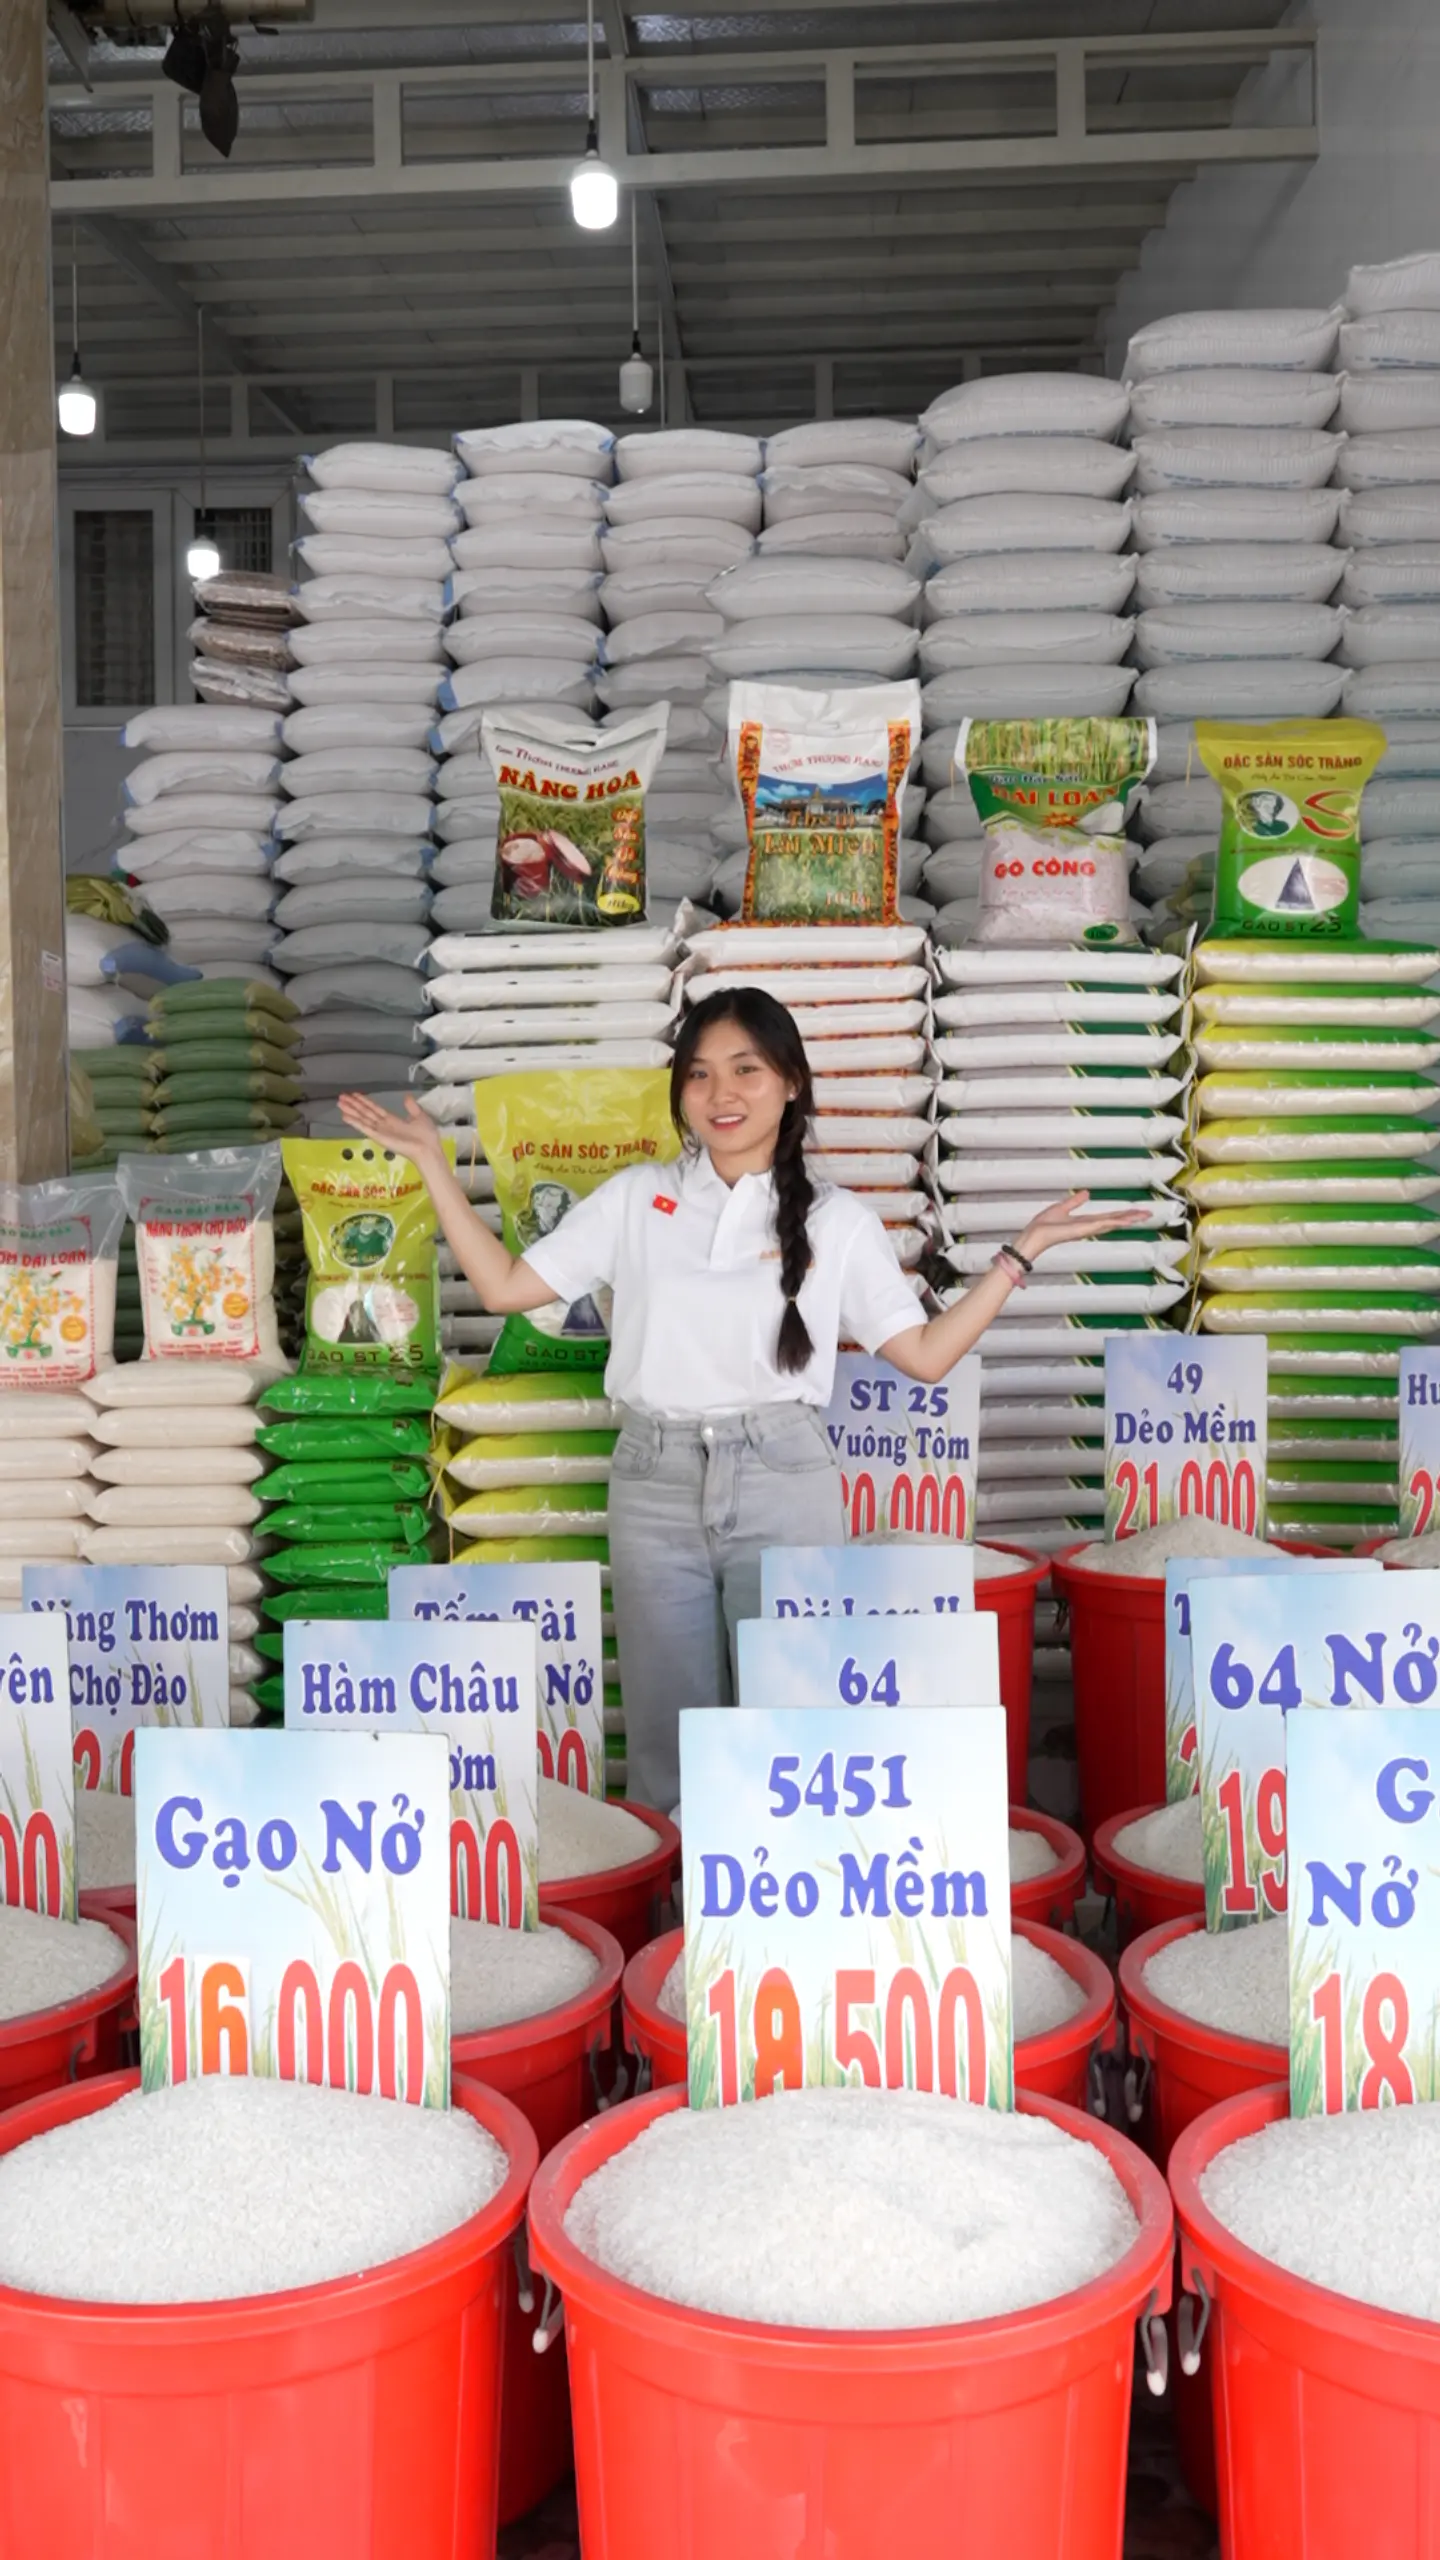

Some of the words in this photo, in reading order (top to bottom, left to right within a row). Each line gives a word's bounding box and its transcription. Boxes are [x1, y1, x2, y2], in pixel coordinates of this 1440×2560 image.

[584, 767, 642, 803] HOA
[1032, 856, 1096, 877] CÔNG
[540, 1138, 573, 1160] SẢN
[850, 1378, 898, 1412] ST
[907, 1385, 949, 1418] 25
[1166, 1361, 1204, 1394] 49
[826, 1424, 908, 1467] Vuông
[914, 1426, 970, 1461] Tôm
[1114, 1408, 1174, 1445] Dẻo
[1183, 1403, 1257, 1443] Mềm
[889, 1472, 967, 1541] 000
[1115, 1460, 1159, 1541] 21
[1179, 1459, 1256, 1537] 000
[125, 1599, 219, 1642] Thơm
[0, 1651, 54, 1705] ên
[69, 1663, 123, 1716] Chợ
[130, 1662, 187, 1706] Đào
[301, 1663, 397, 1714] Hàm
[410, 1660, 520, 1714] Châu
[545, 1658, 595, 1706] Nở
[838, 1657, 900, 1708] 64
[1209, 1642, 1303, 1717] 64
[1324, 1621, 1440, 1707] Nở
[768, 1752, 912, 1818] 5451
[155, 1796, 299, 1887] Gạo
[320, 1793, 425, 1875] Nở
[700, 1845, 820, 1918] Dẻo
[839, 1836, 988, 1918] Mềm
[1305, 1854, 1420, 1929] Nở
[159, 1956, 249, 2084] 16
[277, 1959, 425, 2105] 000
[707, 1966, 803, 2105] 18
[834, 1966, 987, 2105] 500
[1313, 1971, 1414, 2116] 18
